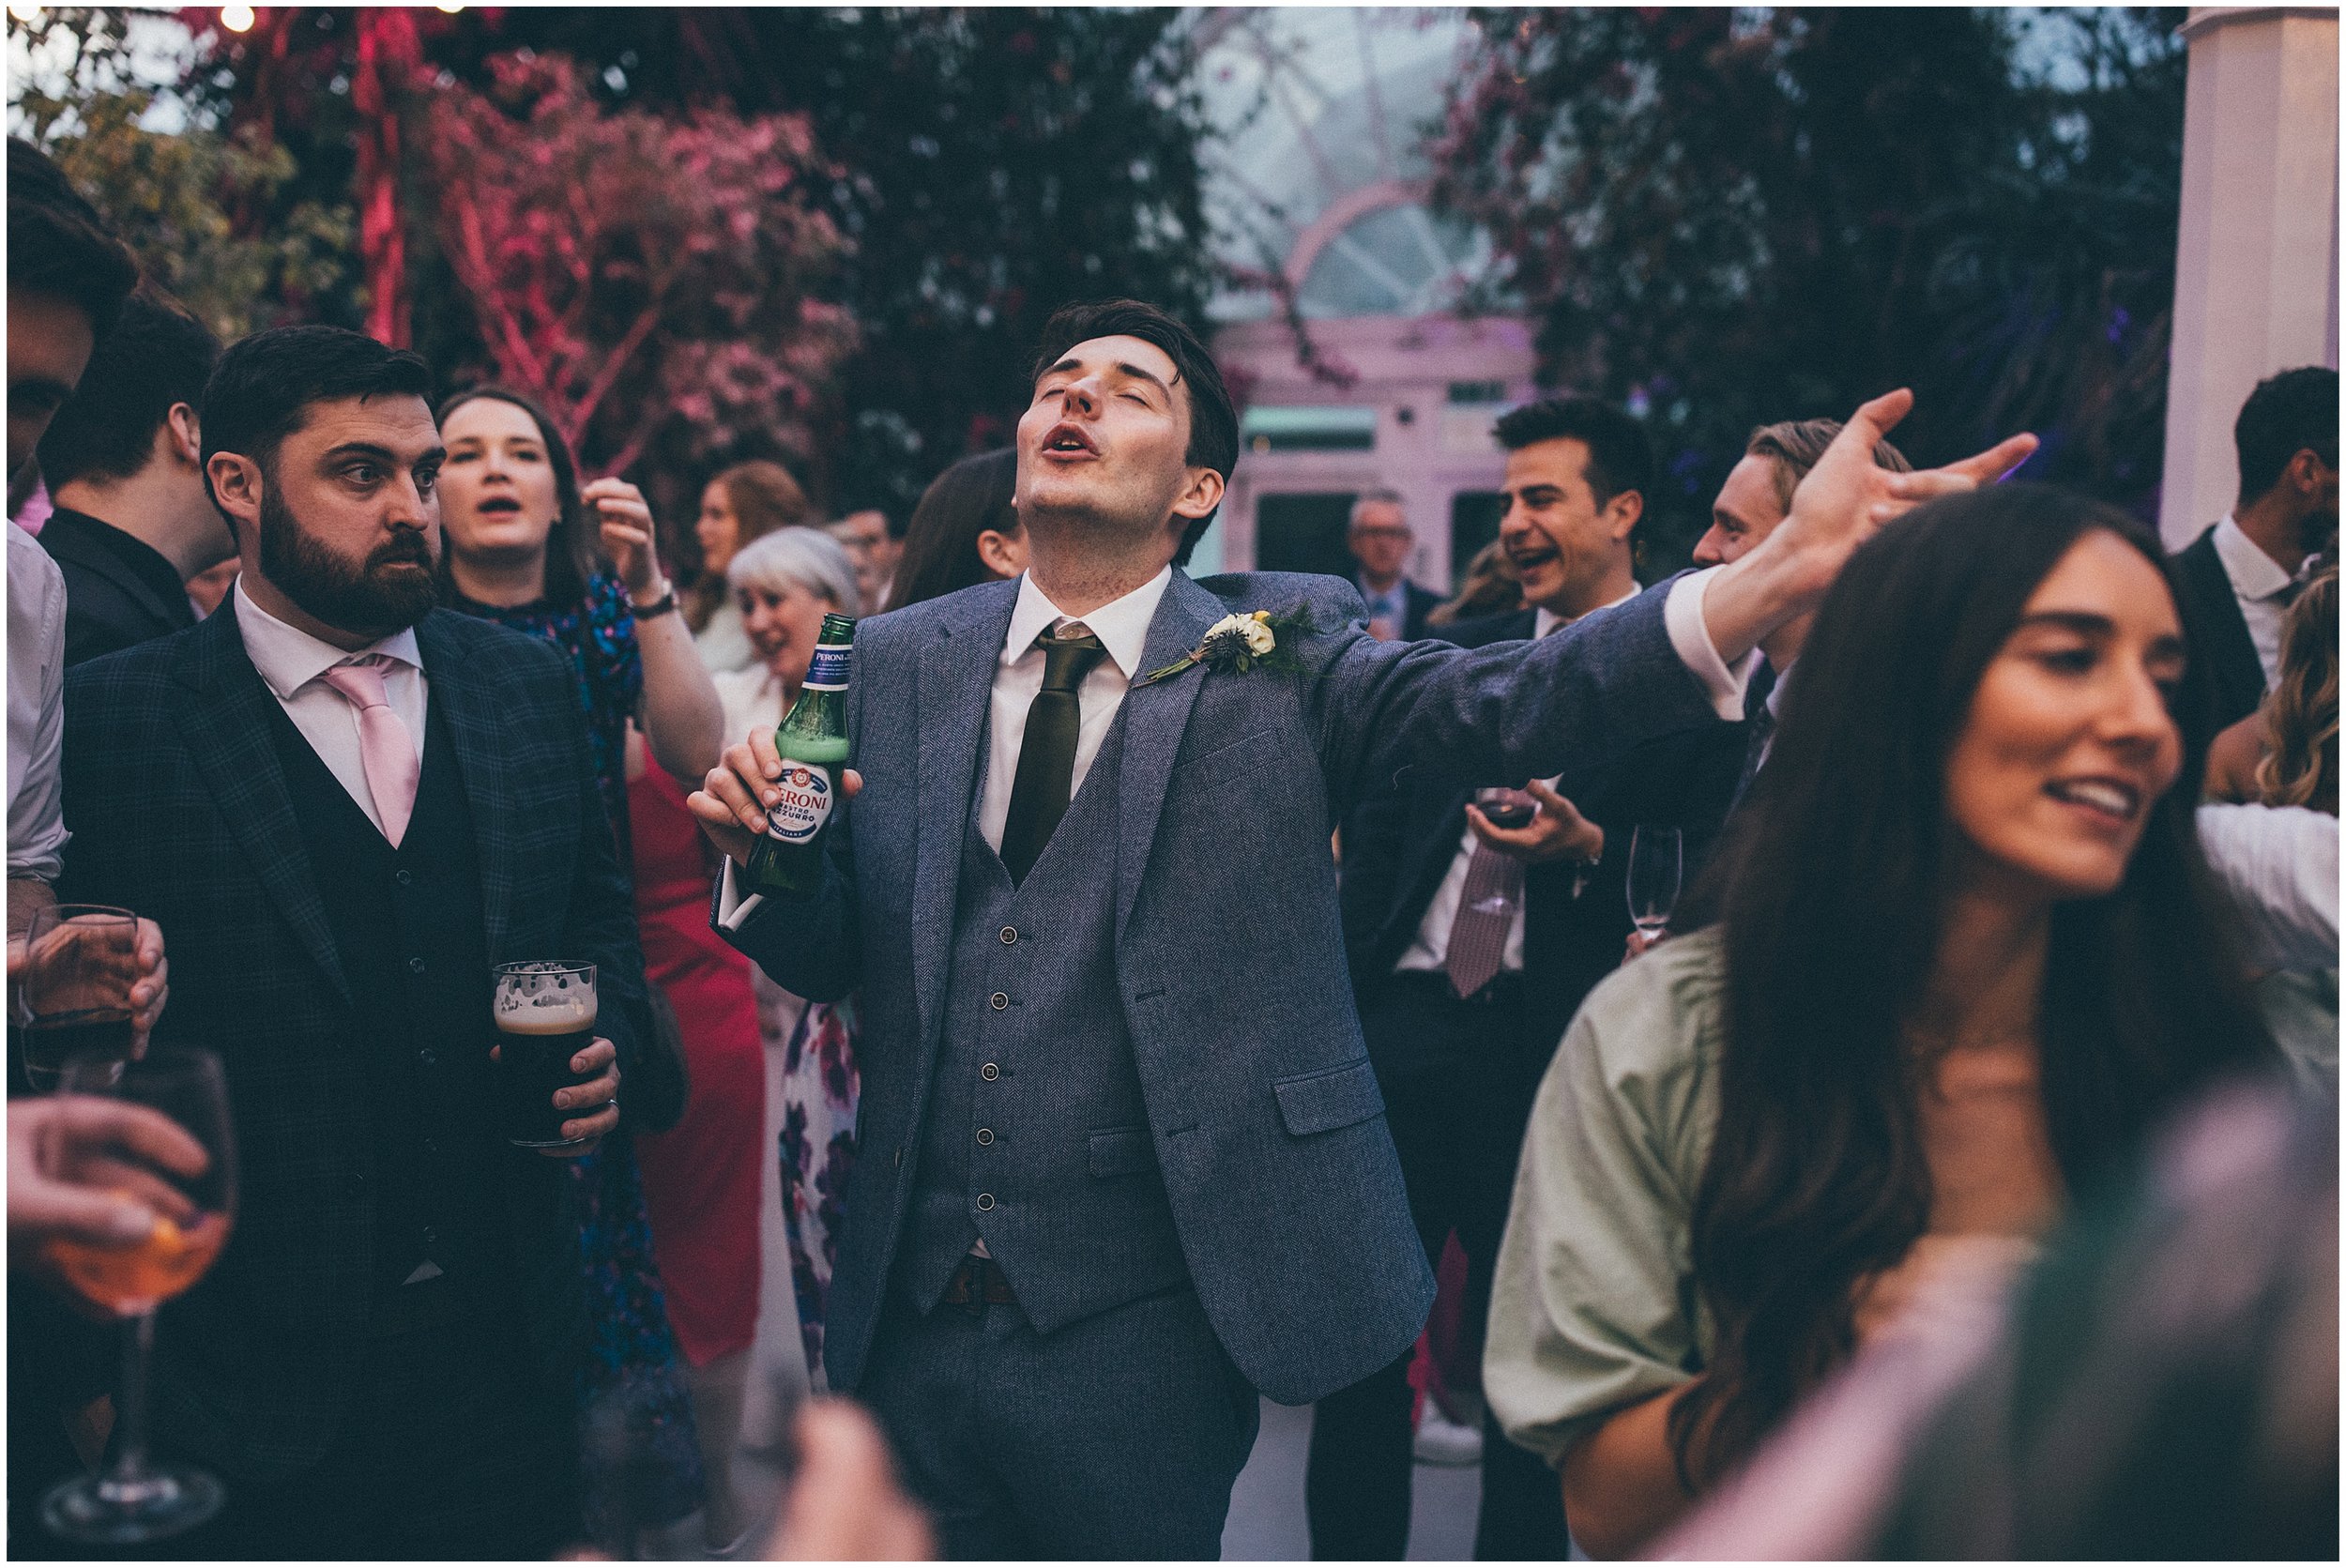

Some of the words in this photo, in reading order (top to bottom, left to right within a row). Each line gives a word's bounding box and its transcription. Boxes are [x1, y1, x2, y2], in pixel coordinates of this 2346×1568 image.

[816, 652, 844, 661] PERONI
[779, 787, 827, 809] ERONI
[773, 825, 802, 836] ITALIANA
